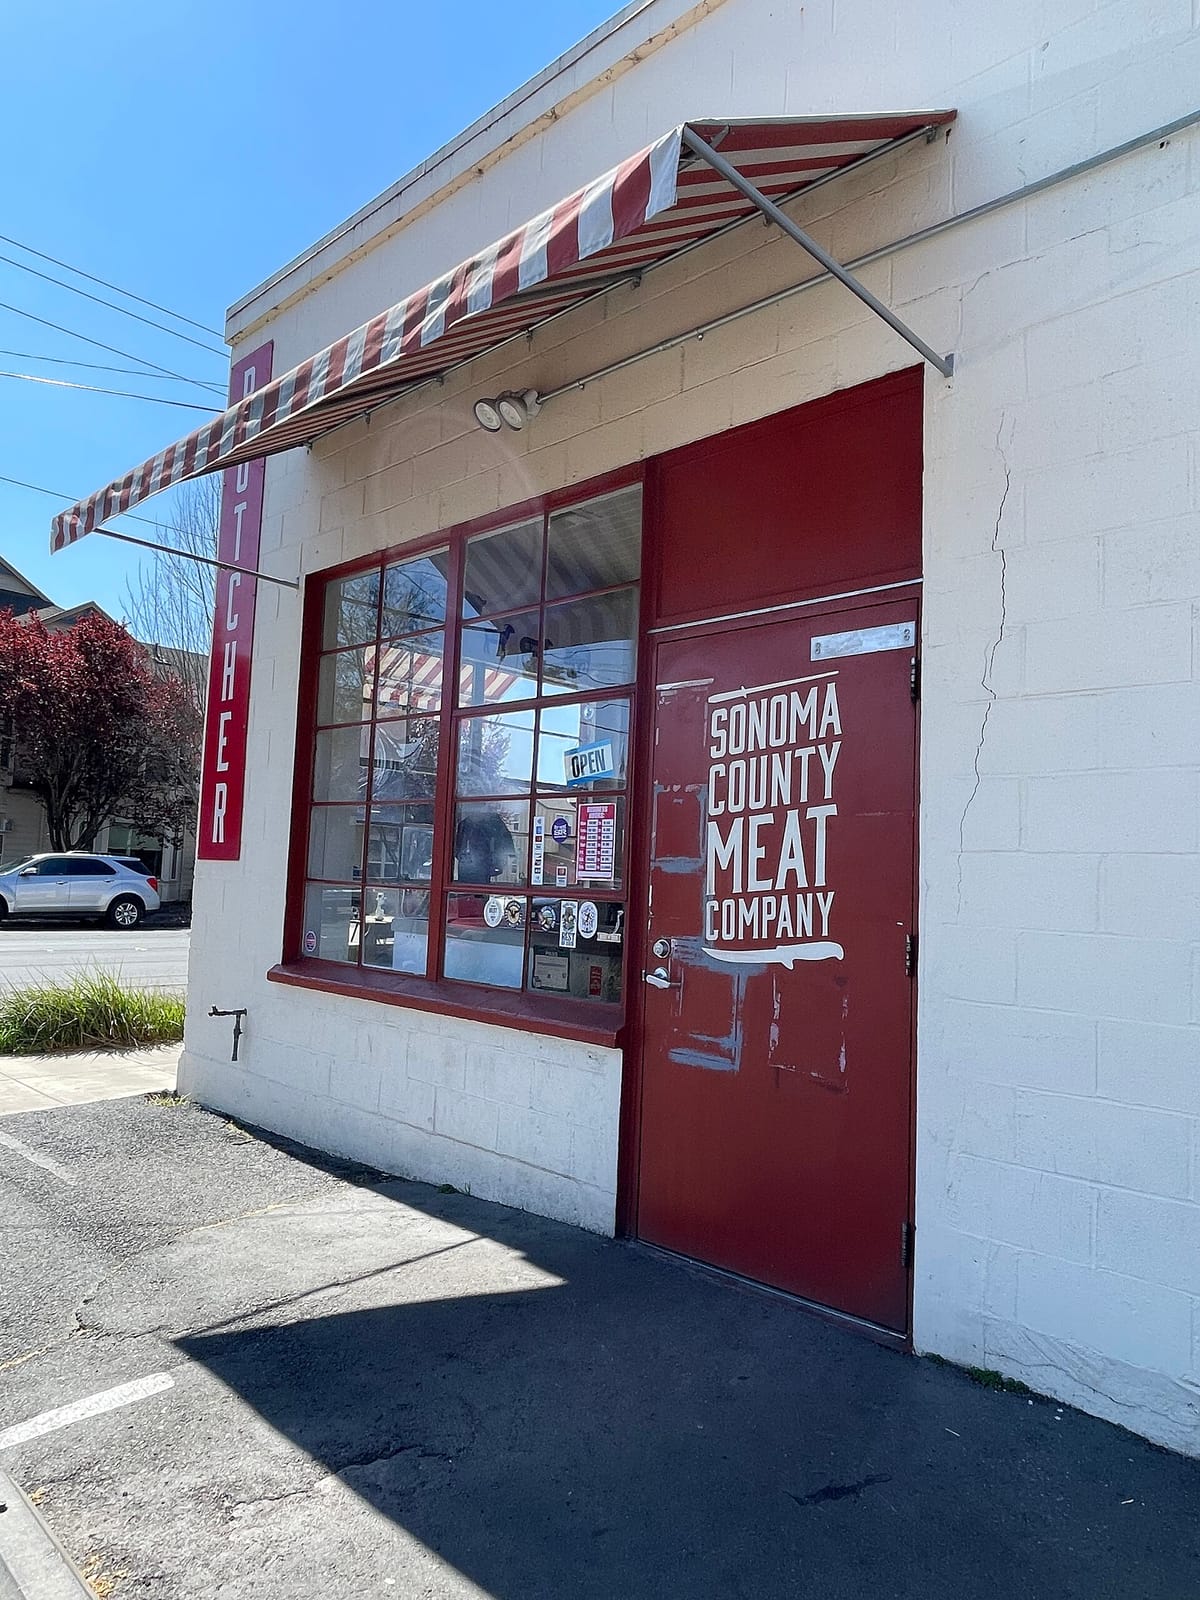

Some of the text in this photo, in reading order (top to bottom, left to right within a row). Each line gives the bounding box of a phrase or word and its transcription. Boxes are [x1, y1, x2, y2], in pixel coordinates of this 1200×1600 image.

[710, 682, 842, 759] SONOMA
[571, 748, 606, 779] OPEN
[708, 741, 842, 816] COUNTY
[707, 804, 838, 896] MEAT
[705, 892, 835, 941] COMPANY
